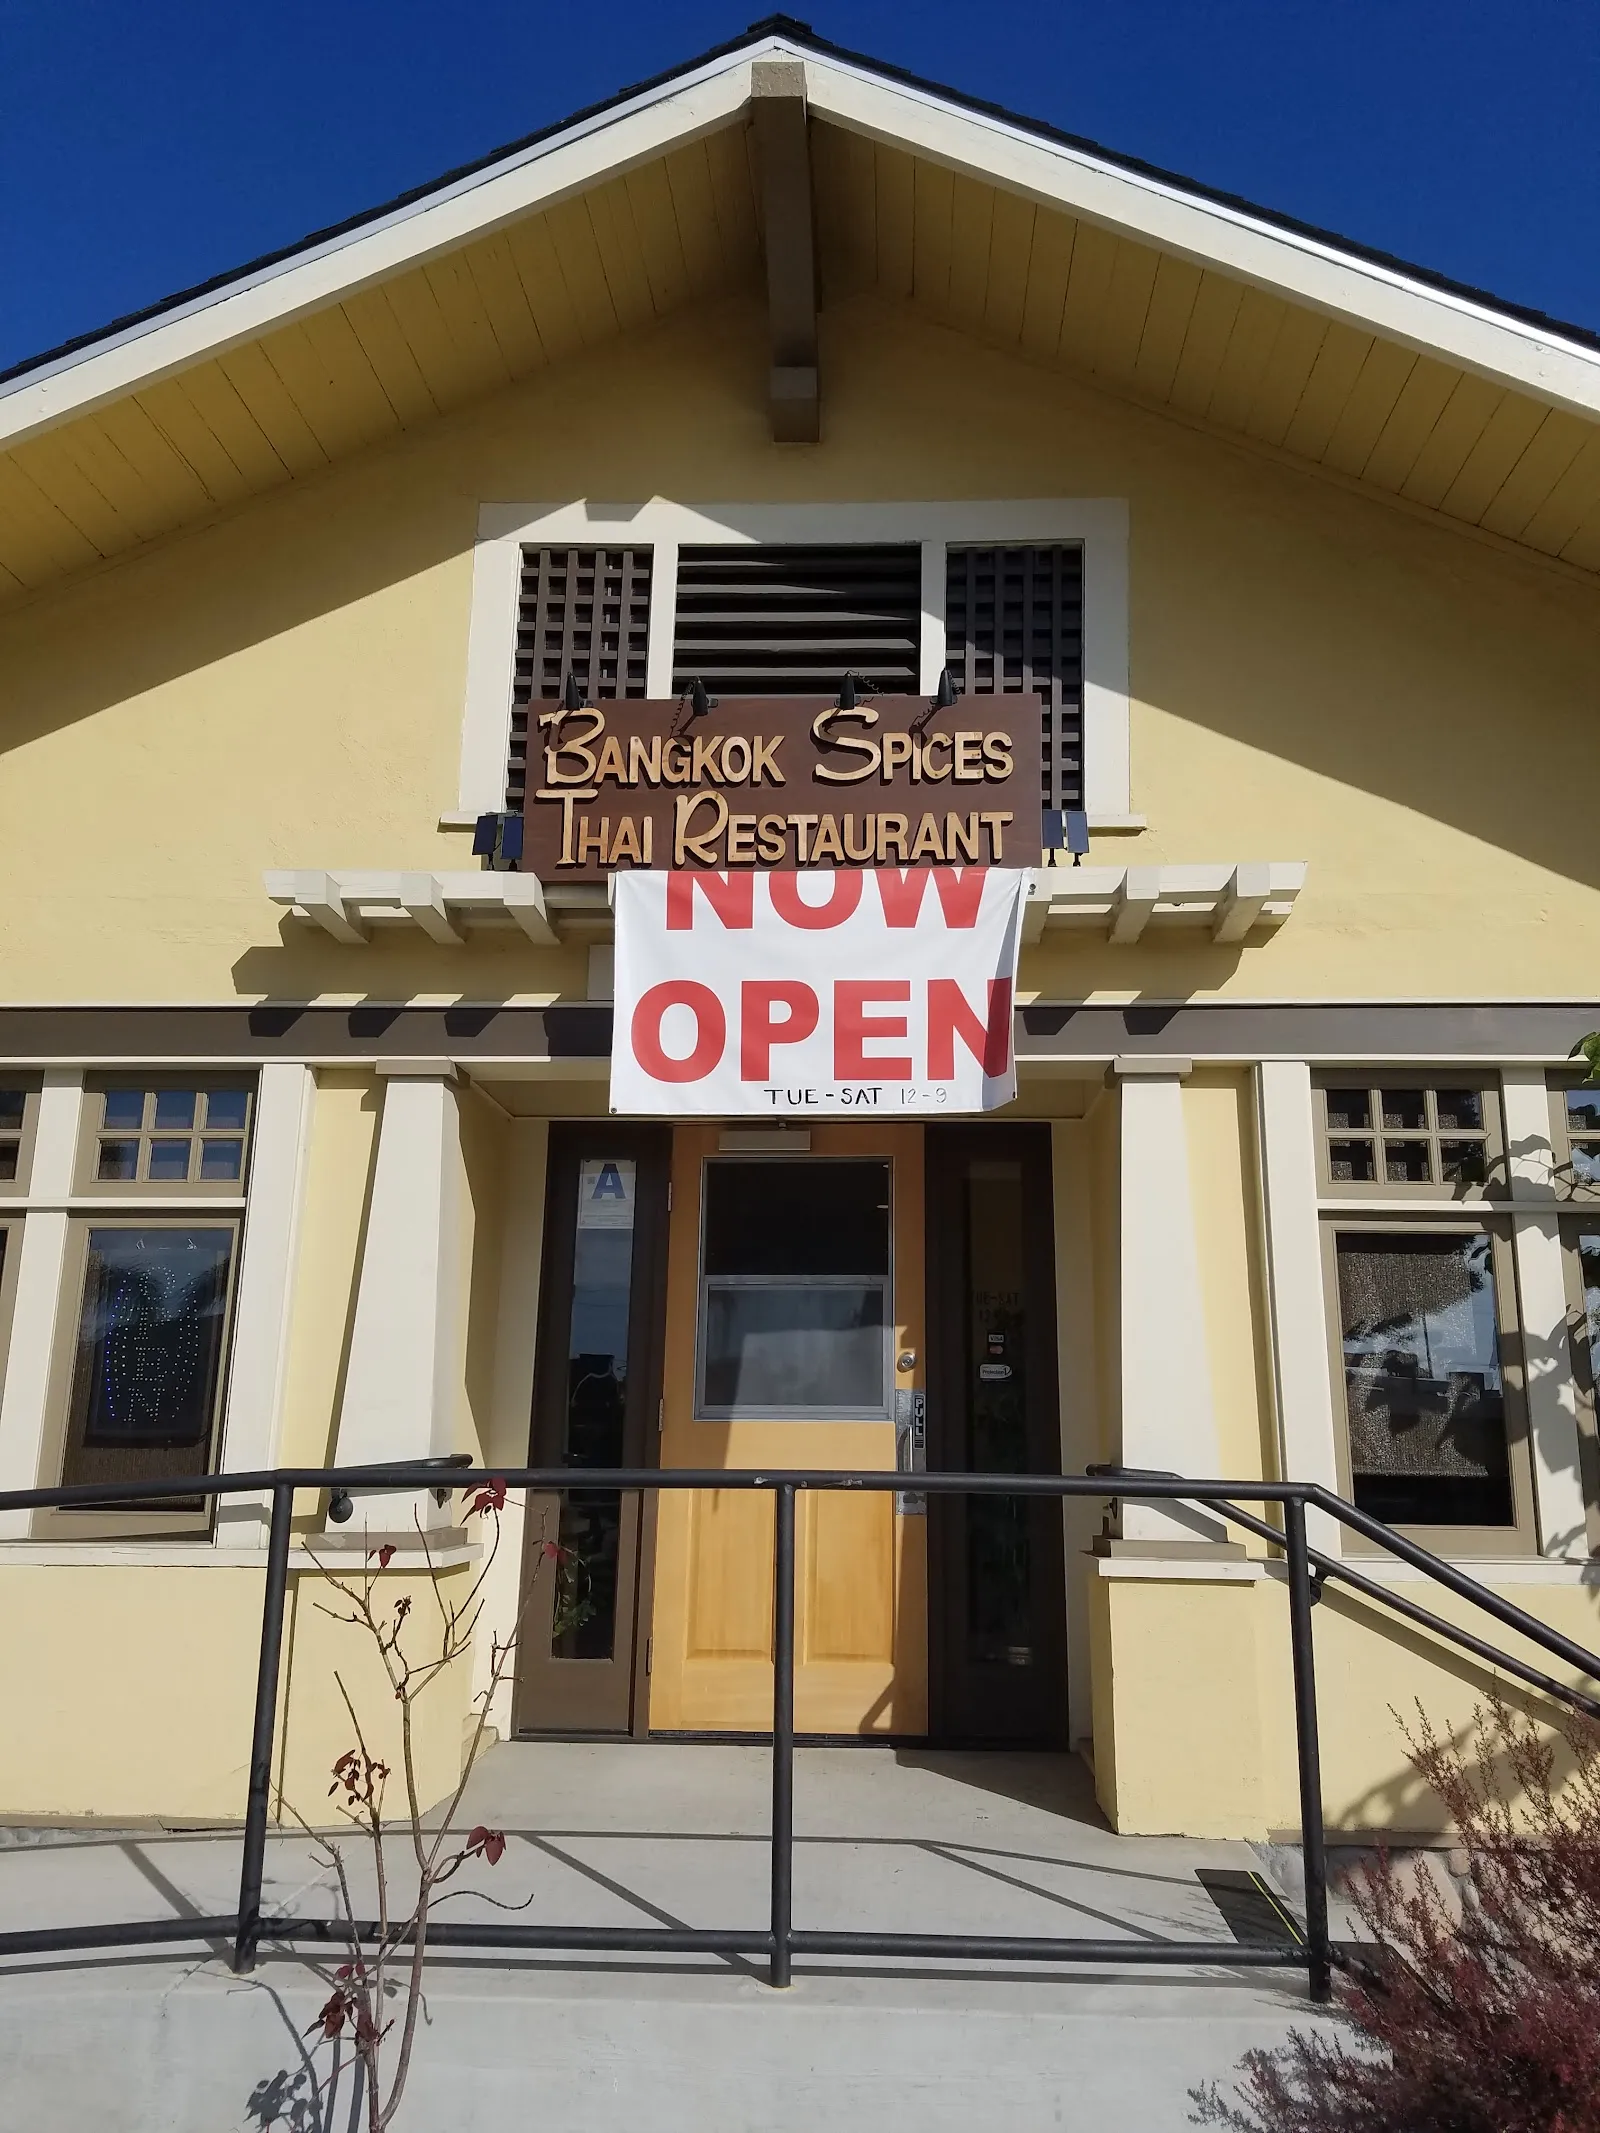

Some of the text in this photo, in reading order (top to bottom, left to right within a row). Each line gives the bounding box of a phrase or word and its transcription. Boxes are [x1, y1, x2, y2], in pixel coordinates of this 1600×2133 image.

[538, 706, 1014, 784] BANGKOK SPICES
[535, 788, 1014, 866] THAI RESTAURANT
[666, 867, 989, 931] NOW
[631, 976, 1013, 1083] OPEN
[591, 1163, 627, 1200] A
[915, 1398, 924, 1436] PULL
